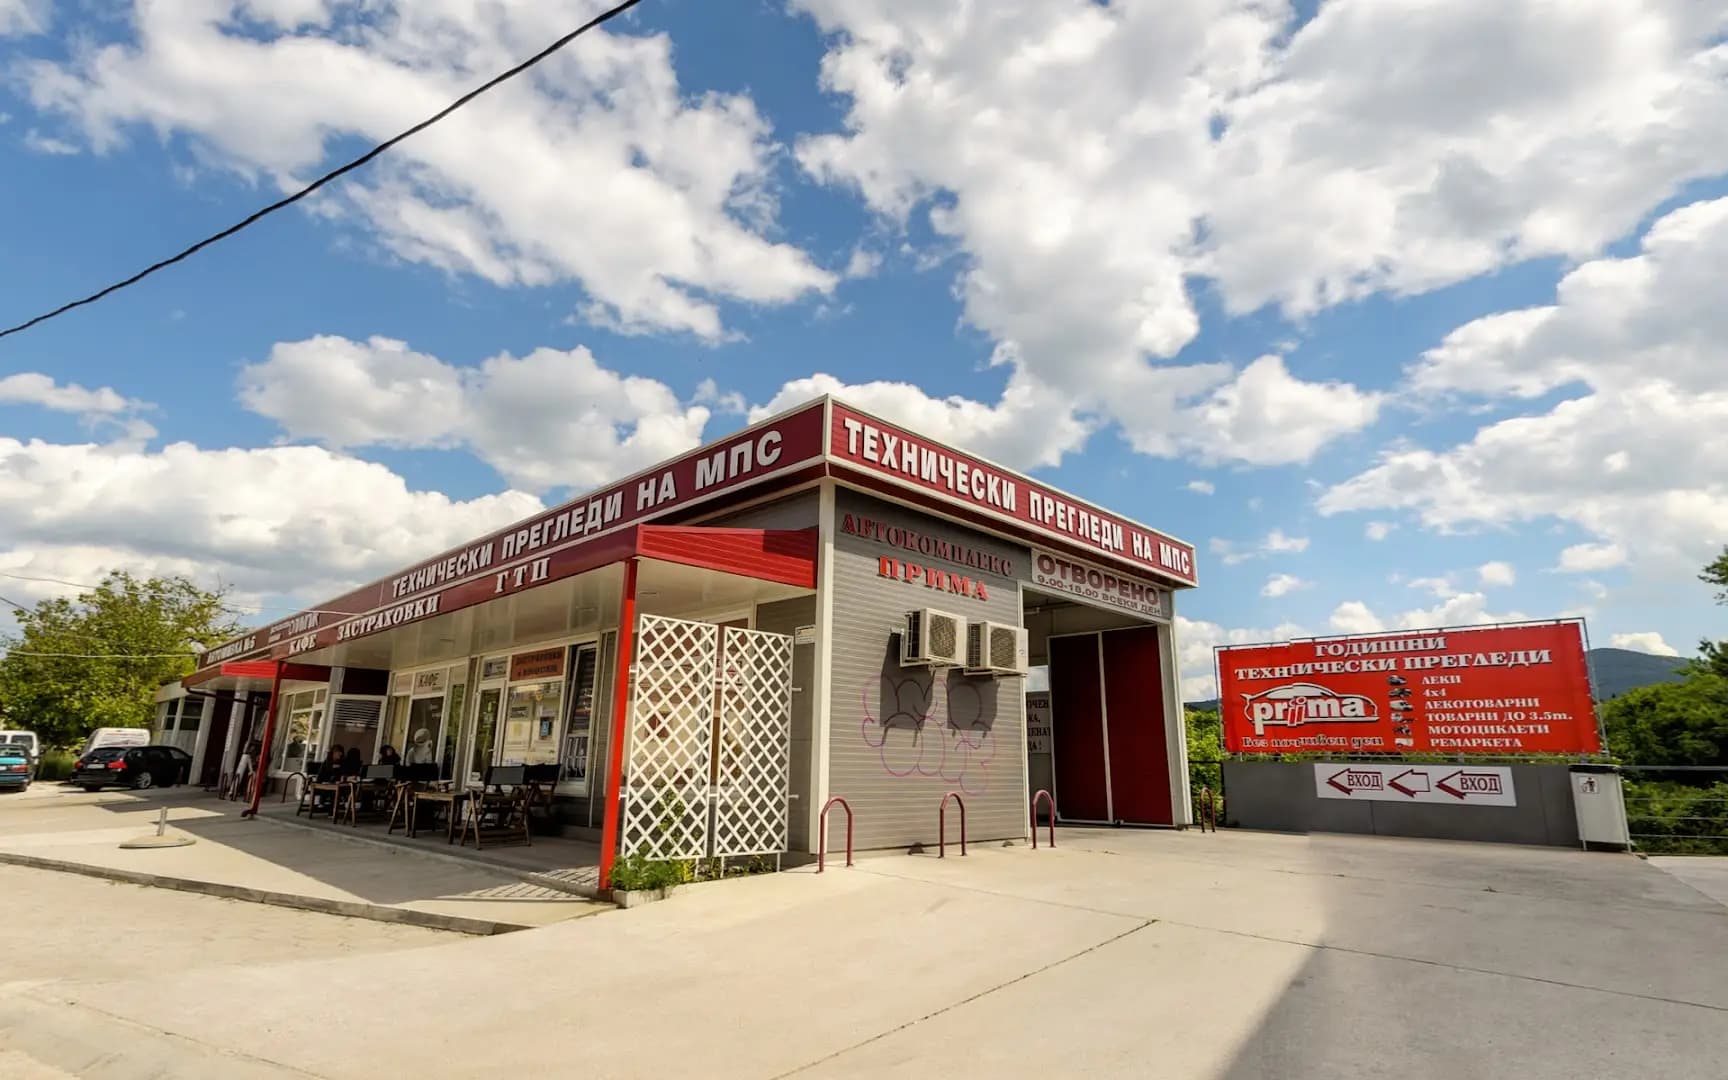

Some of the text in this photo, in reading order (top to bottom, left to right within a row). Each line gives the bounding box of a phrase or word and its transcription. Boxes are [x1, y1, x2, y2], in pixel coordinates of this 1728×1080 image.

[844, 416, 1191, 575] ТЕХНИЧЕСКИ ПРЕГЛЕДИ НА МПС
[392, 430, 782, 598] ТЕХНИЧЕСКИ ПРЕГЛЕДИ НА МПС
[840, 513, 1014, 577] АВТОКОМПЛЕКС
[494, 557, 550, 594] ГТП
[878, 555, 989, 601] ПРИМА
[1037, 554, 1159, 605] ОТВОРЕНО
[1102, 594, 1138, 610] ВСЕКИ
[1141, 604, 1161, 615] ДЕН
[337, 594, 441, 641] ЗАСТРАХОВКИ
[288, 633, 317, 656] КАФЕ
[1315, 635, 1447, 657] ГОДИШНИ
[1235, 649, 1552, 681] ТЕХНИЧЕСКИ ПРЕГЛЕДИ
[1422, 675, 1461, 685] ЛЕКИ
[1425, 698, 1540, 709] ЛЕКОТОВАРНИ
[1425, 712, 1498, 722] ТОВАРНИ
[1503, 711, 1526, 723] ДО
[1428, 724, 1550, 735] МОТОЦИКЛЕТИ
[1430, 738, 1523, 748] РЕМАРКЕТА
[1347, 774, 1381, 788] ВХОД
[1460, 777, 1499, 792] ВХОД
